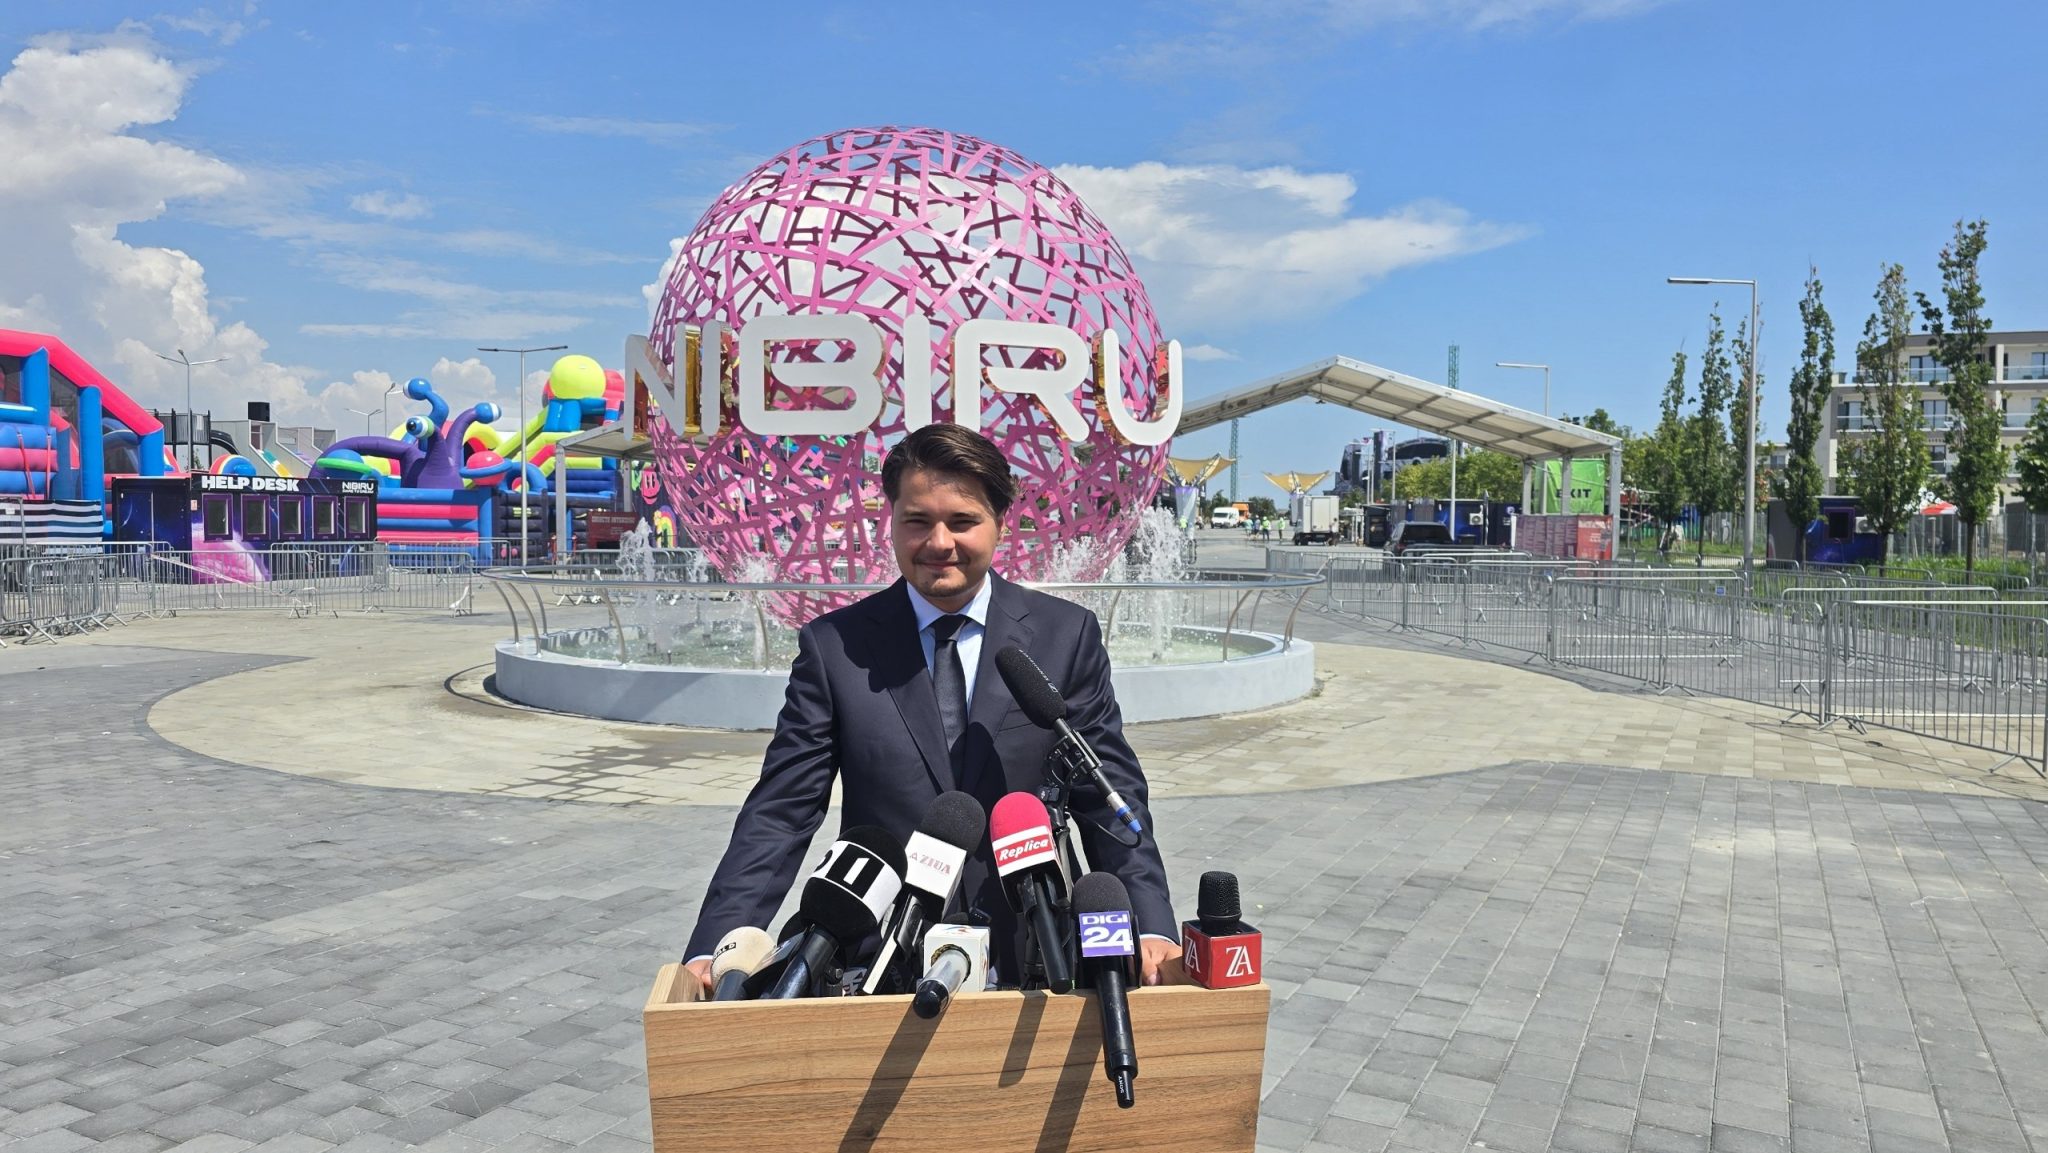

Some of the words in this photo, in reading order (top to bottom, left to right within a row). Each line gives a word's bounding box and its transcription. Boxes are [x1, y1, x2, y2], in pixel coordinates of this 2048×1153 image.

[624, 313, 1183, 446] NIBIRU
[201, 475, 250, 490] HELP
[252, 477, 300, 491] DESK
[342, 481, 374, 491] NIBIRU
[999, 838, 1049, 861] Replica
[1082, 913, 1129, 925] DIGI
[1082, 926, 1134, 952] 24
[1225, 945, 1256, 978] ZA
